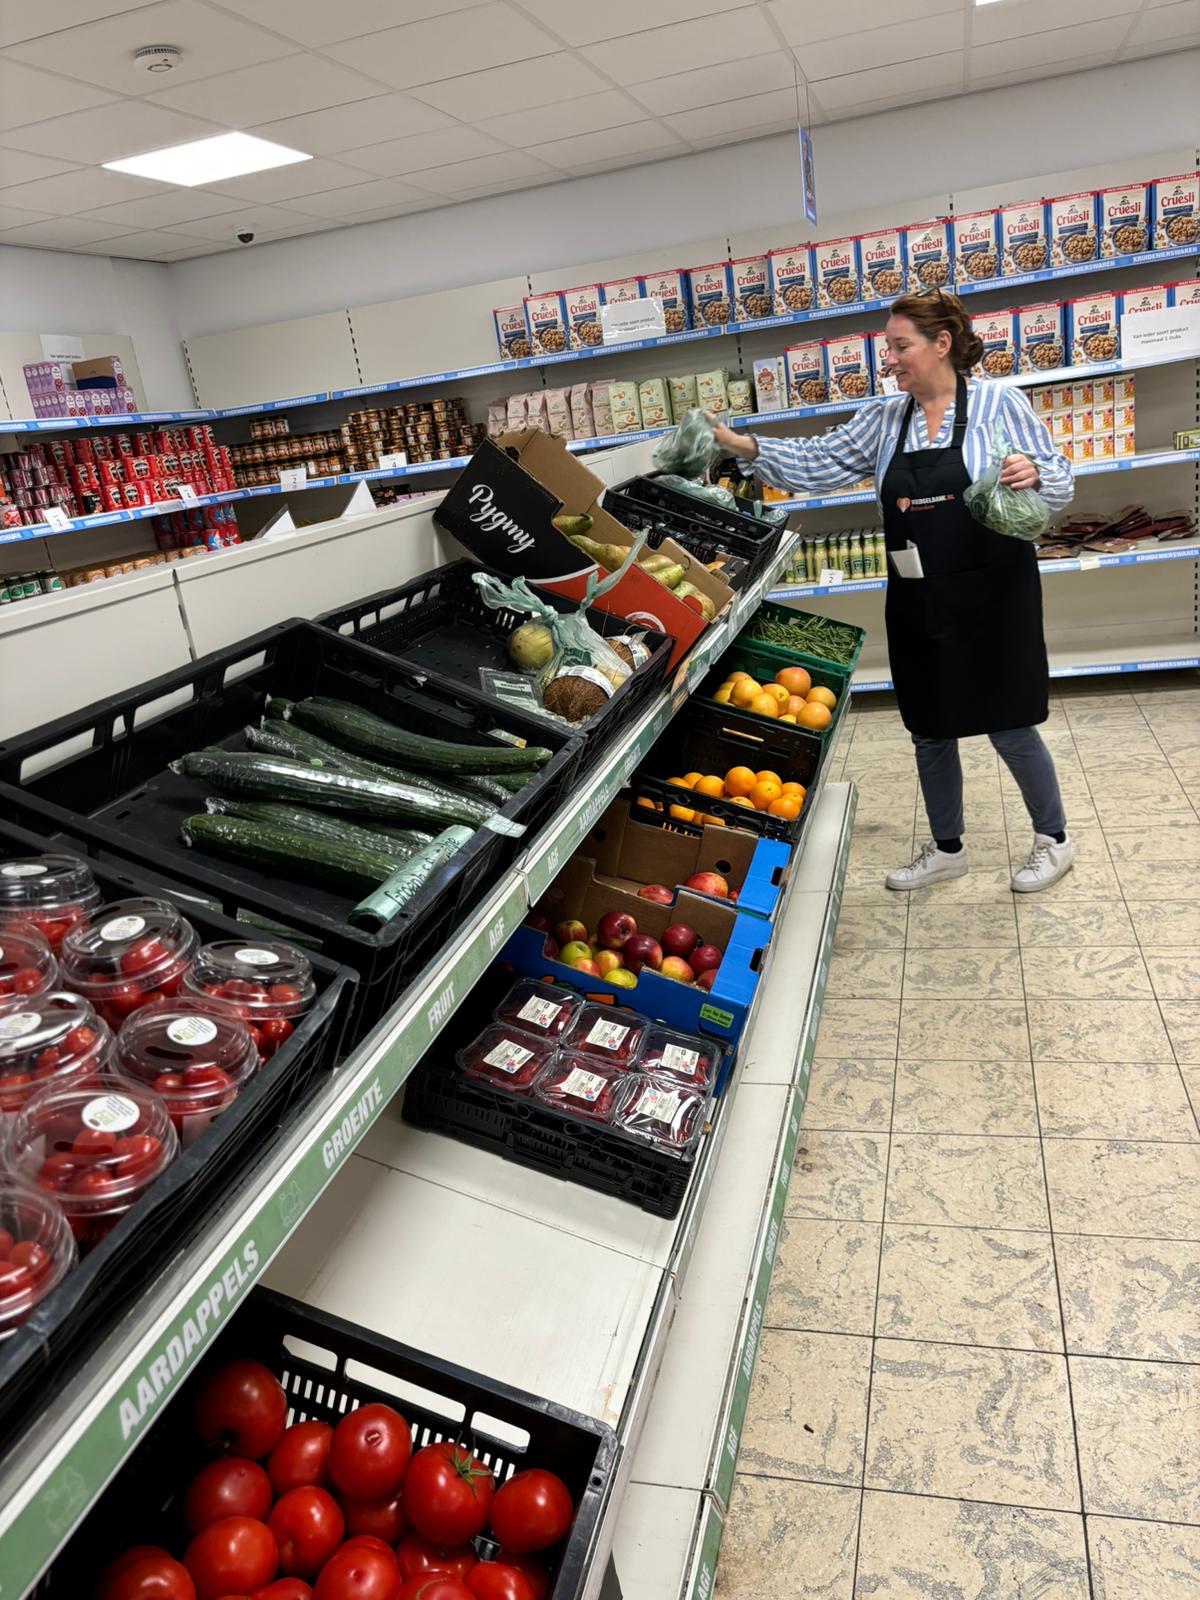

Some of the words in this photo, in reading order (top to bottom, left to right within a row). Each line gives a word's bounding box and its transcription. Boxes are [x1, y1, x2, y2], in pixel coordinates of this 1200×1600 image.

[1161, 192, 1195, 208] Cruesli
[1056, 210, 1090, 226] Cruesli
[1108, 202, 1142, 218] Cruesli
[1007, 219, 1040, 235] Cruesli
[958, 228, 990, 244] Cruesli
[865, 246, 896, 262] Cruesli
[911, 238, 943, 254] Cruesli
[1133, 246, 1198, 262] KRUIDENIERSWAREN
[776, 262, 806, 278] Cruesli
[820, 254, 850, 270] Cruesli
[1052, 260, 1116, 276] KRUIDENIERSWAREN
[695, 280, 723, 294] Cruesli
[737, 272, 765, 286] Cruesli
[532, 307, 558, 322] Cruesli
[570, 301, 596, 314] Cruesli
[1077, 310, 1112, 326] Cruesli
[1024, 320, 1056, 336] Cruesli
[792, 358, 820, 373] Cruesli
[832, 352, 862, 365] Cruesli
[468, 484, 536, 554] Pygmy
[1136, 550, 1200, 562] KRUIDENIERSWAREN
[1137, 659, 1199, 670] KRUIDENIERSWAREN
[547, 847, 561, 873] AGF
[488, 916, 507, 950] AGF
[427, 984, 456, 1032] FRUIT
[322, 1080, 385, 1169] GROENTE
[762, 1216, 779, 1263] GROENTE
[120, 1239, 261, 1439] AARDAPPELS
[740, 1299, 763, 1379] AARDAPPELS
[726, 1423, 740, 1458] AGF
[697, 1562, 712, 1599] AGF
